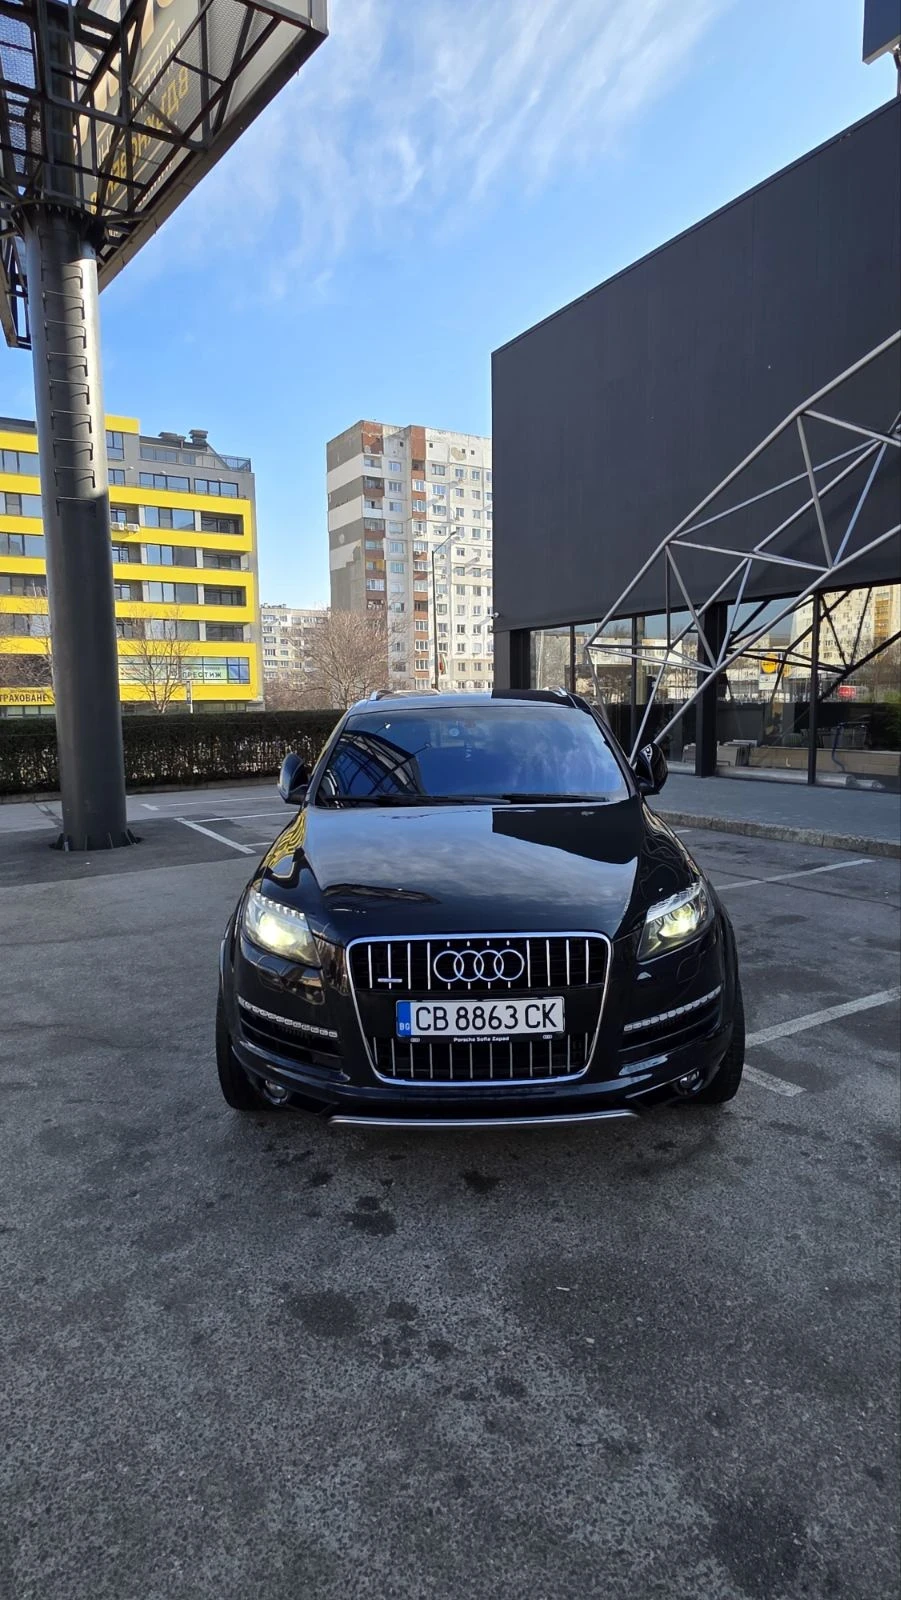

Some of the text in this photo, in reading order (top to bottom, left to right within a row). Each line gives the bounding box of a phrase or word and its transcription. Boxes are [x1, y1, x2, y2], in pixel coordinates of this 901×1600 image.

[415, 1002, 558, 1031] CB 8863 CK
[399, 1022, 410, 1031] BG
